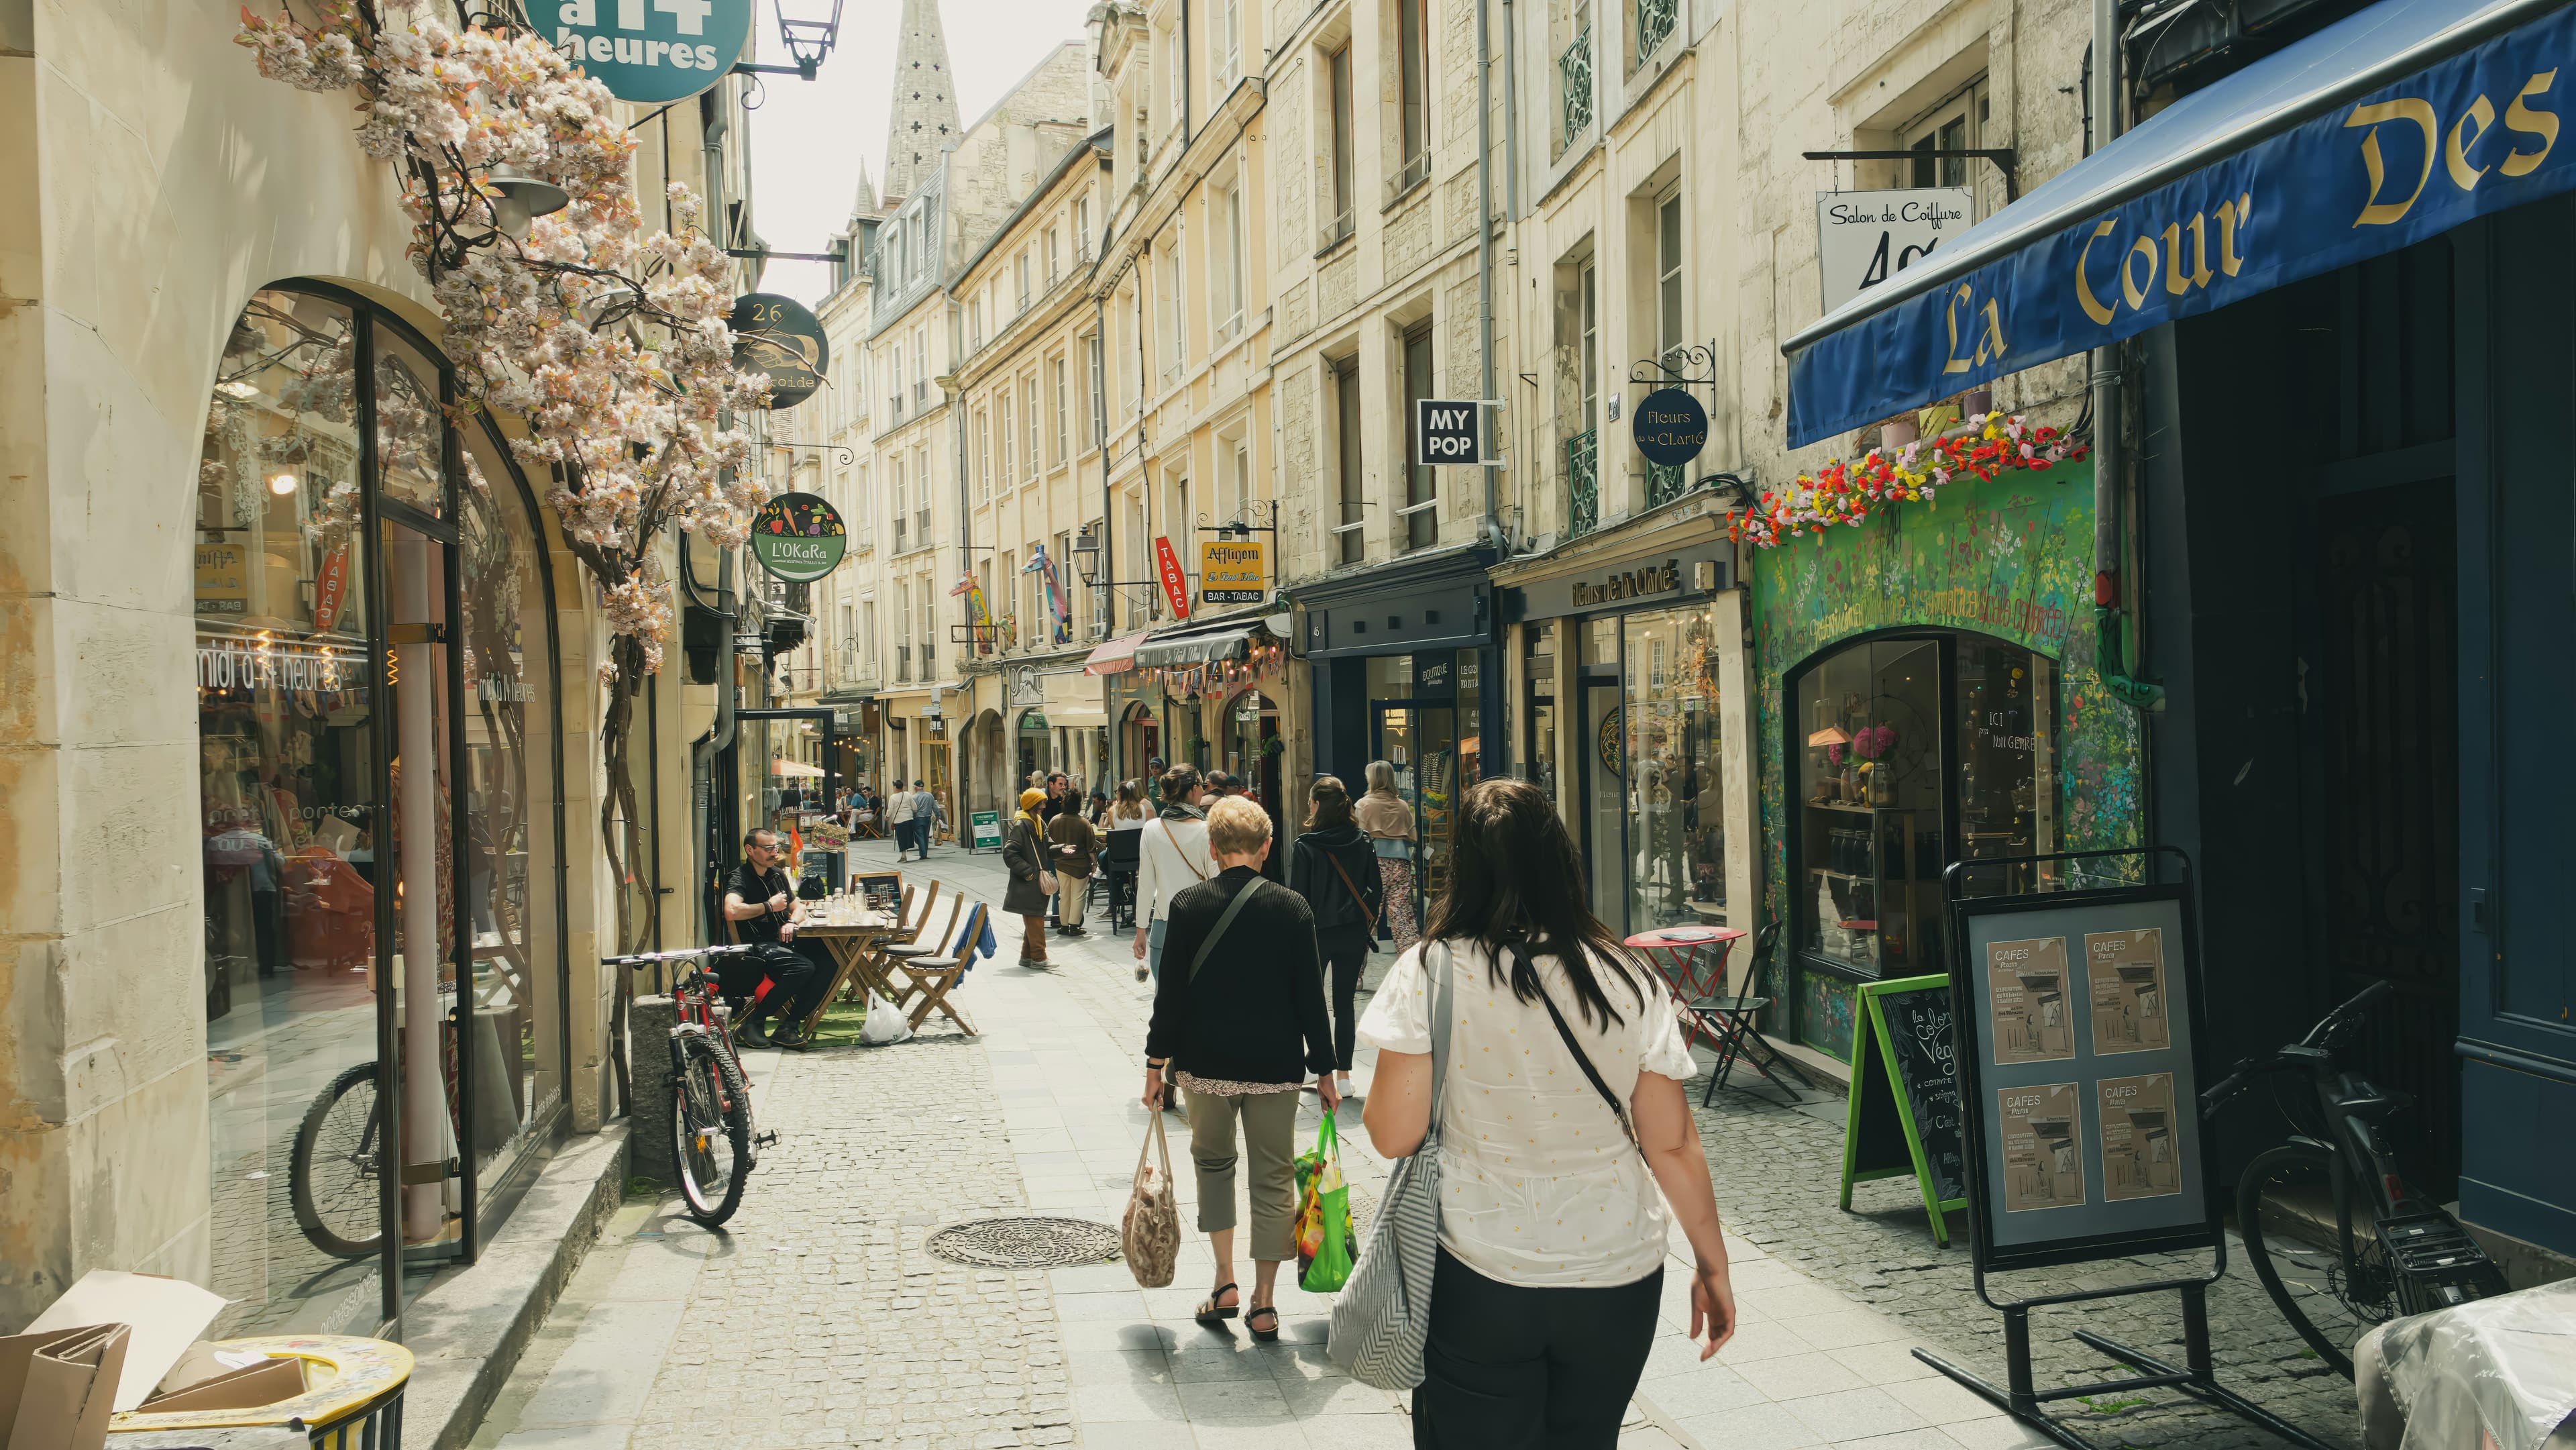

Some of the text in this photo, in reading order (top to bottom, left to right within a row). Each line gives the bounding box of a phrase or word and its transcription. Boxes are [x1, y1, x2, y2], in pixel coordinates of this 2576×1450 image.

[557, 27, 718, 71] heures
[1829, 202, 1963, 229] Salon de Coiffure
[1942, 66, 2561, 376] La Cour Des
[752, 303, 782, 321] 26
[1430, 409, 1469, 429] MY
[1429, 436, 1472, 456] POP
[1160, 546, 1185, 609] TABAC
[1208, 592, 1259, 601] BAR TABAC
[195, 639, 235, 688] midi
[1996, 949, 2029, 961] CAFES
[2094, 941, 2126, 953] CAFES
[2007, 1095, 2041, 1107] CAFES
[2106, 1086, 2138, 1098] CAFES
